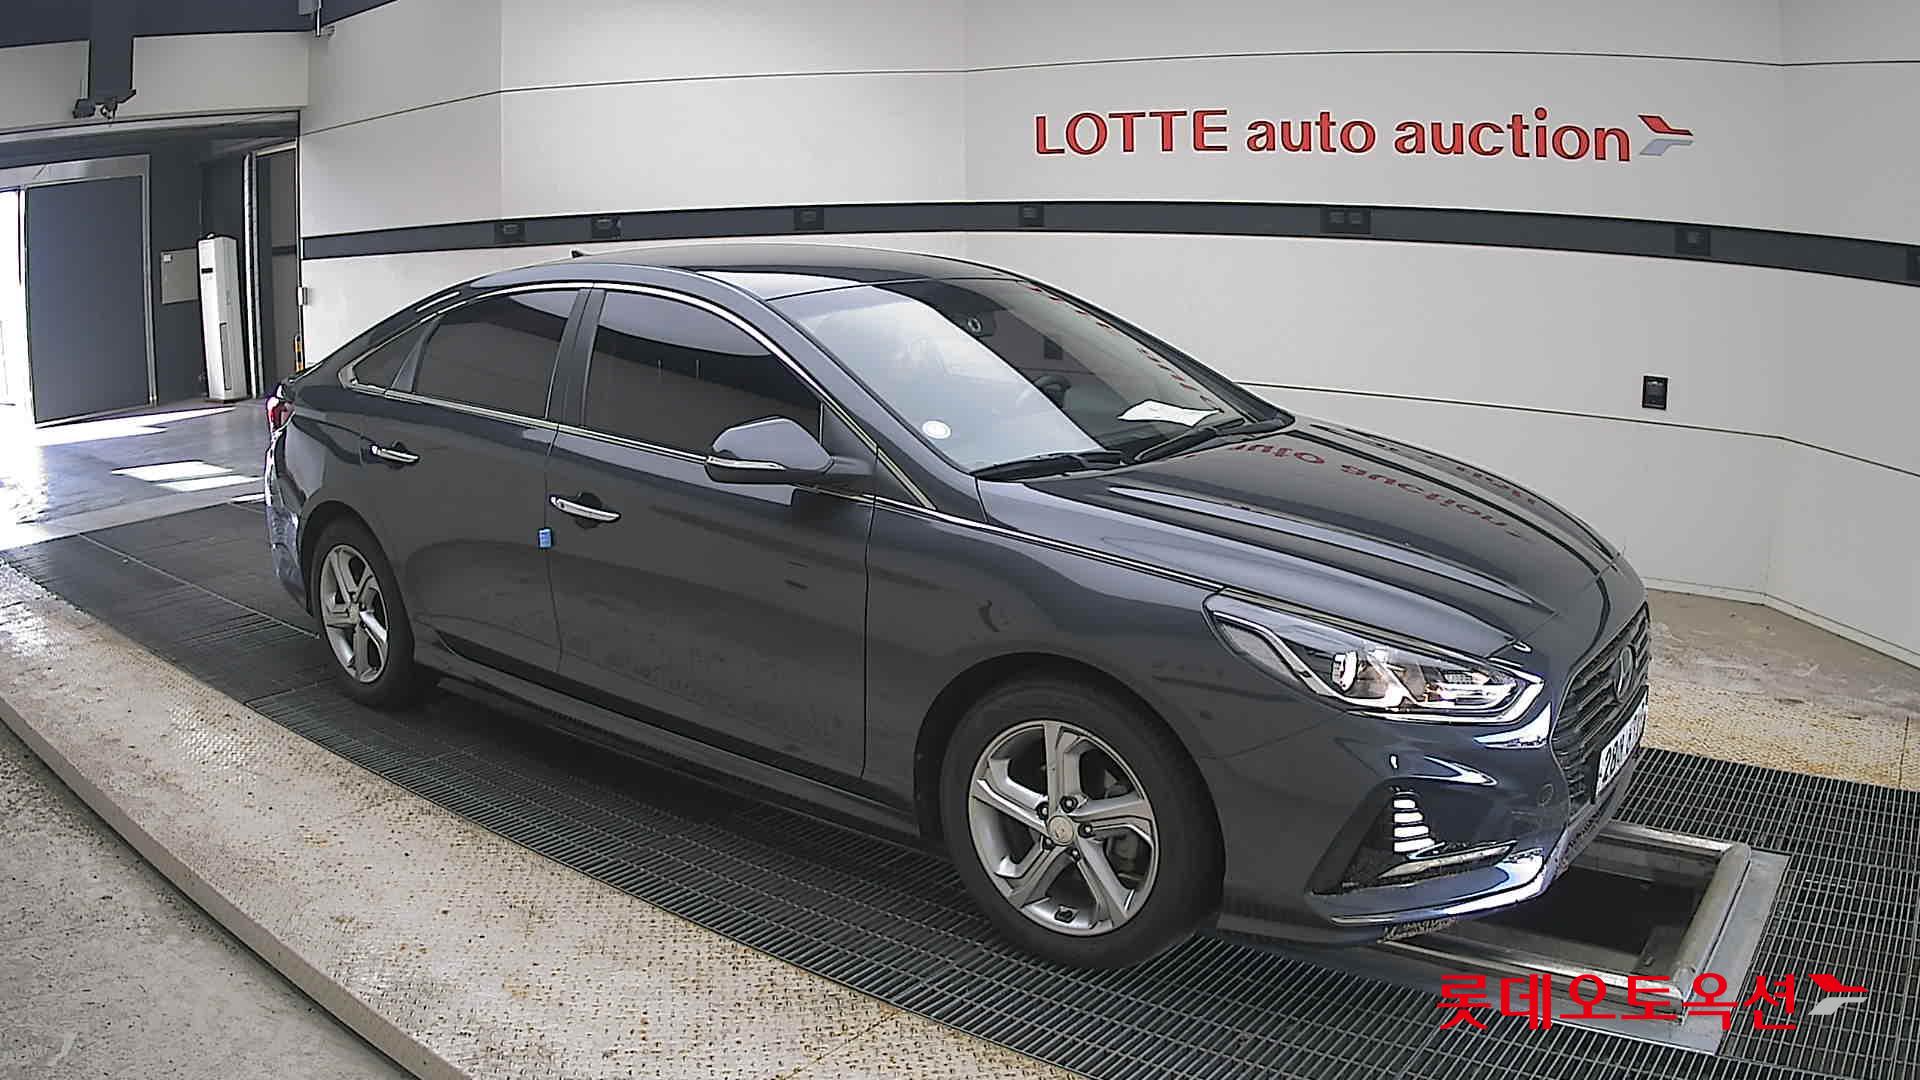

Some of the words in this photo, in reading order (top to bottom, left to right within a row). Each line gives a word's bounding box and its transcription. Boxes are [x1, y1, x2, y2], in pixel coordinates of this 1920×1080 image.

[1035, 109, 1229, 156] LOTTE
[1246, 111, 1377, 155] auto
[1394, 106, 1632, 162] auction
